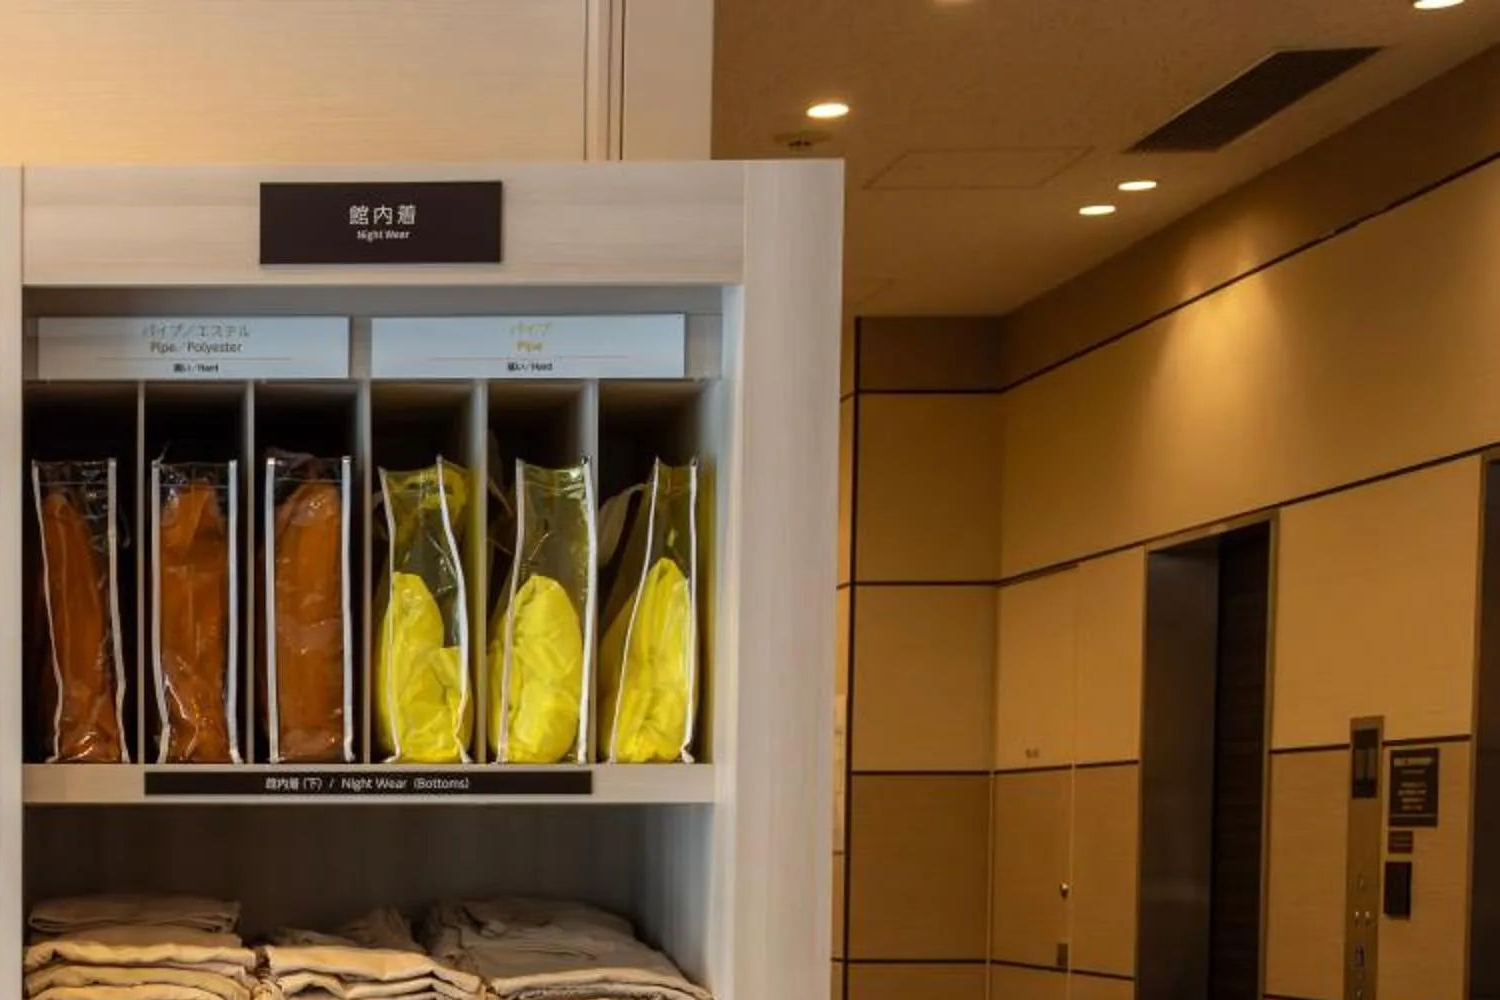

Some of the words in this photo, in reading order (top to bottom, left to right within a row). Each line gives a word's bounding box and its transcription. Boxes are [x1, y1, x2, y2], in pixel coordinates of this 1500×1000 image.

[349, 205, 417, 225] 館内着
[341, 777, 373, 792] Night
[376, 777, 407, 789] Wear
